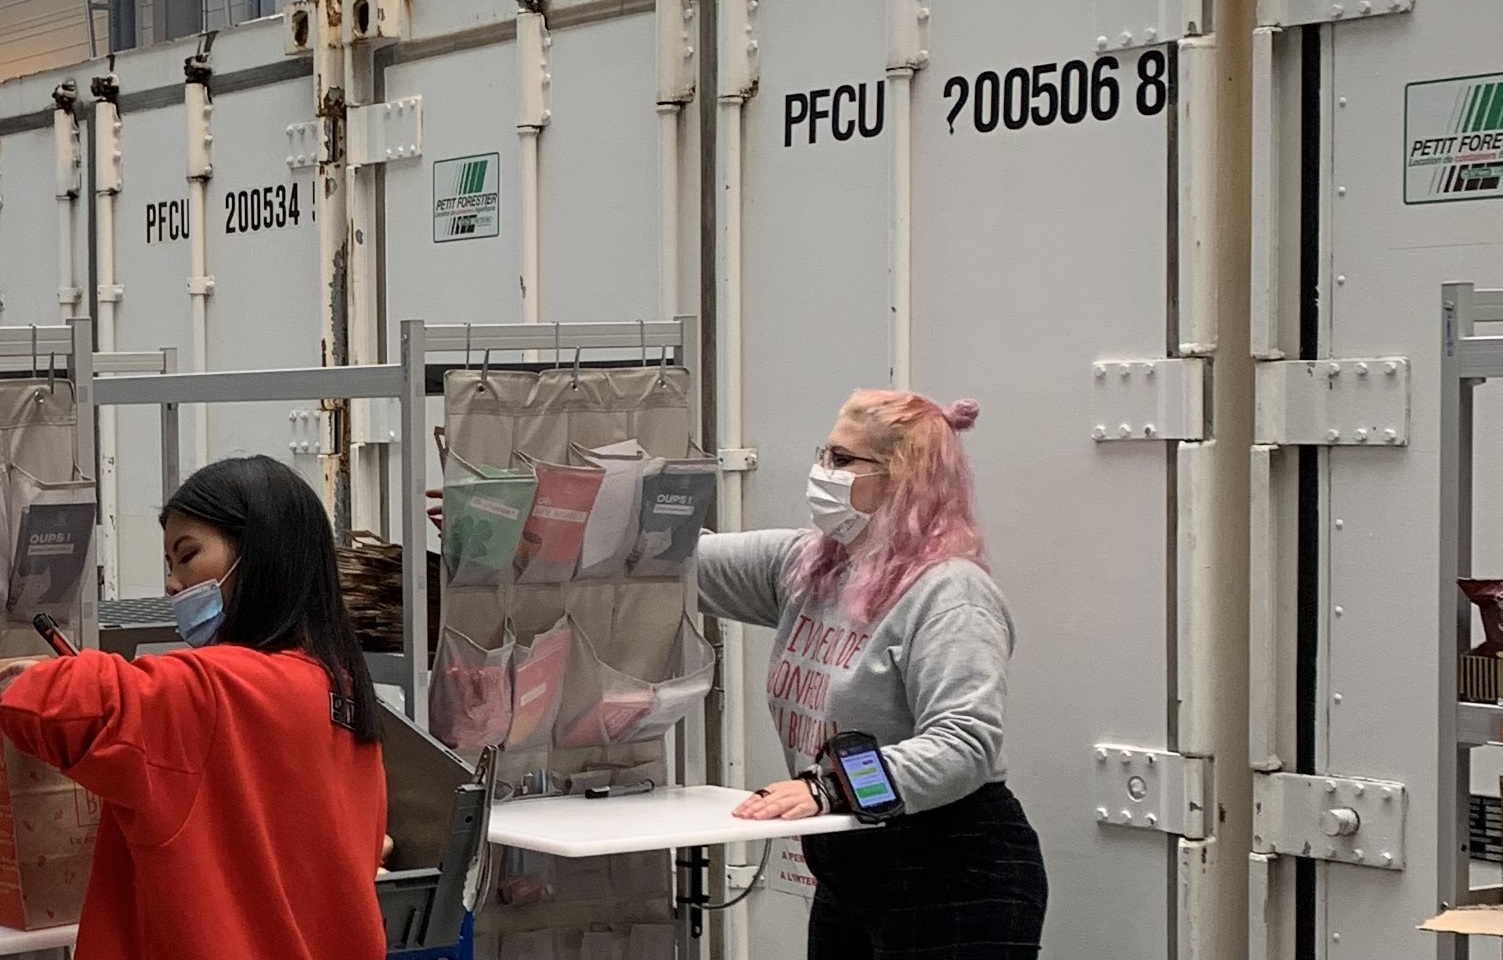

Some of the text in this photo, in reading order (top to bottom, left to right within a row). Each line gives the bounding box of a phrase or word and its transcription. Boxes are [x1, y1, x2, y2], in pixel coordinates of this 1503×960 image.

[783, 79, 885, 147] PFCU
[1135, 49, 1167, 117] 8
[1410, 133, 1503, 158] PETIT FORE
[146, 198, 190, 244] PFCU
[225, 182, 300, 234] 200534
[436, 192, 498, 211] PETIT FORESTIER
[29, 532, 64, 544] OUPS
